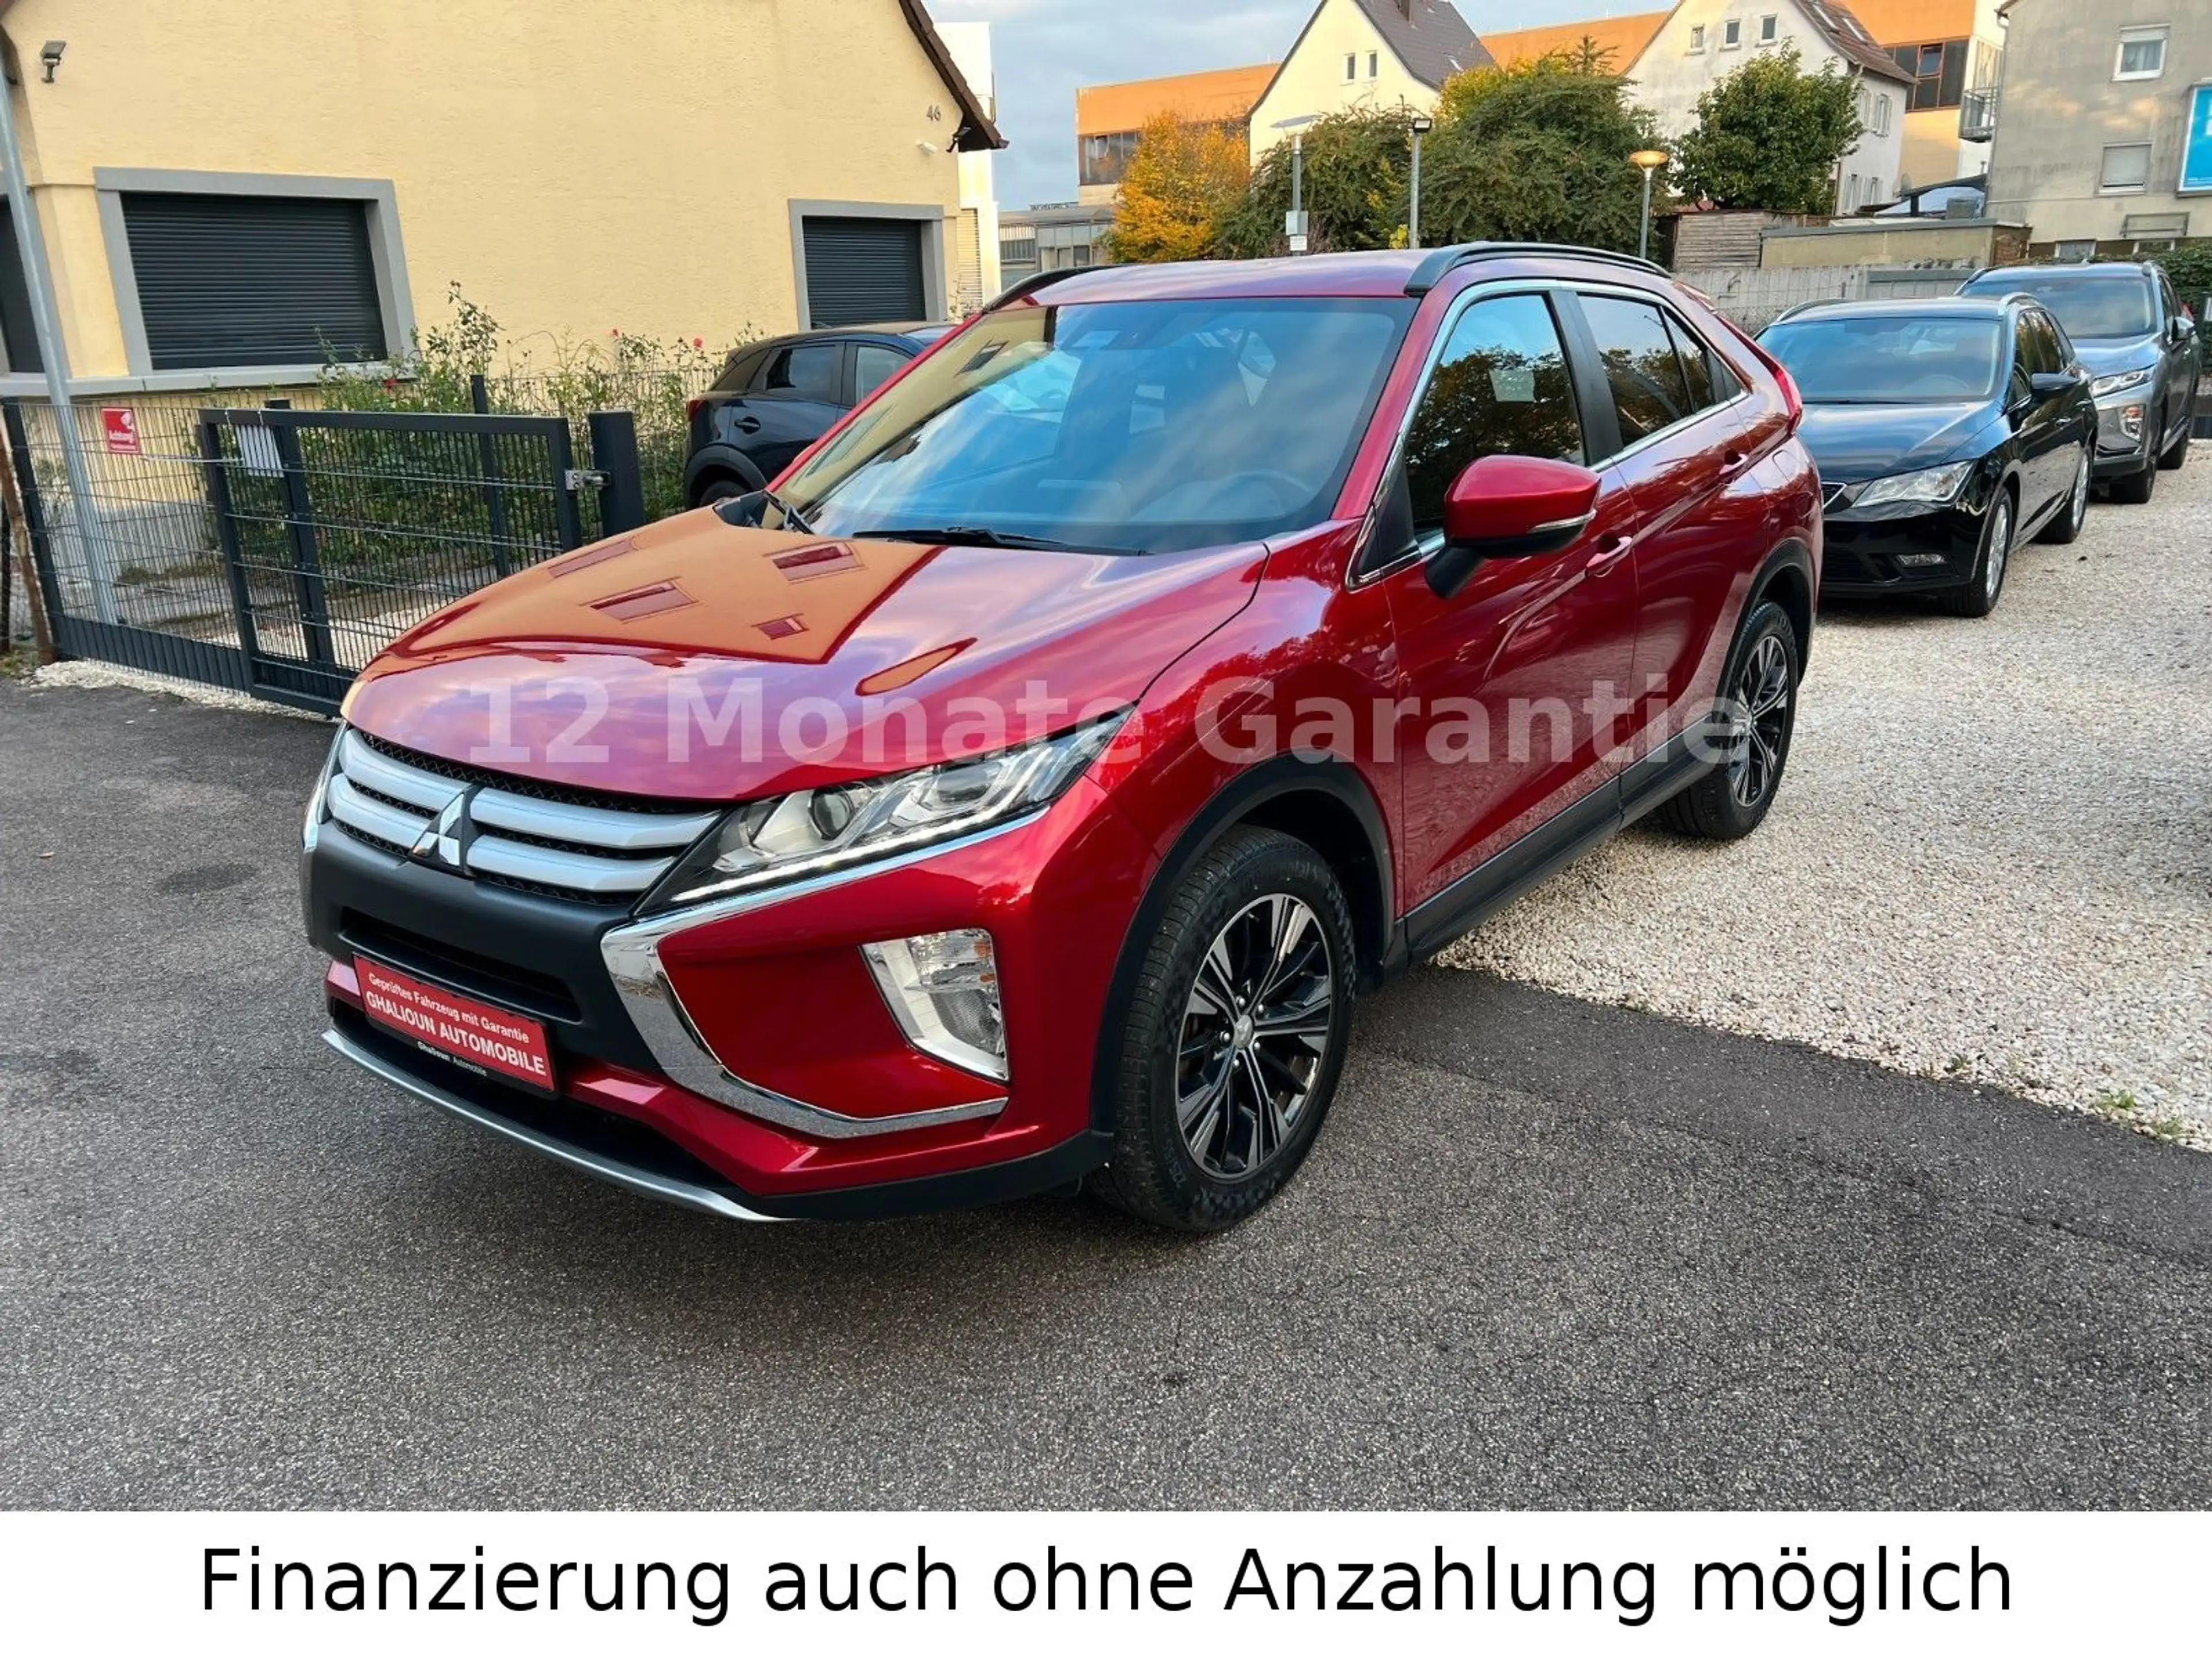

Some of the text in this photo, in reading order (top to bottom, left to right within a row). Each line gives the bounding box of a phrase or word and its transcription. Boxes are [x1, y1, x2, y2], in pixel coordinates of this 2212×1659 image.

[926, 104, 941, 122] 46
[366, 991, 547, 1076] GHALIOUN AUTOMOBILE
[369, 972, 529, 1044] Geprüftes Fahrzeug mit Garantie
